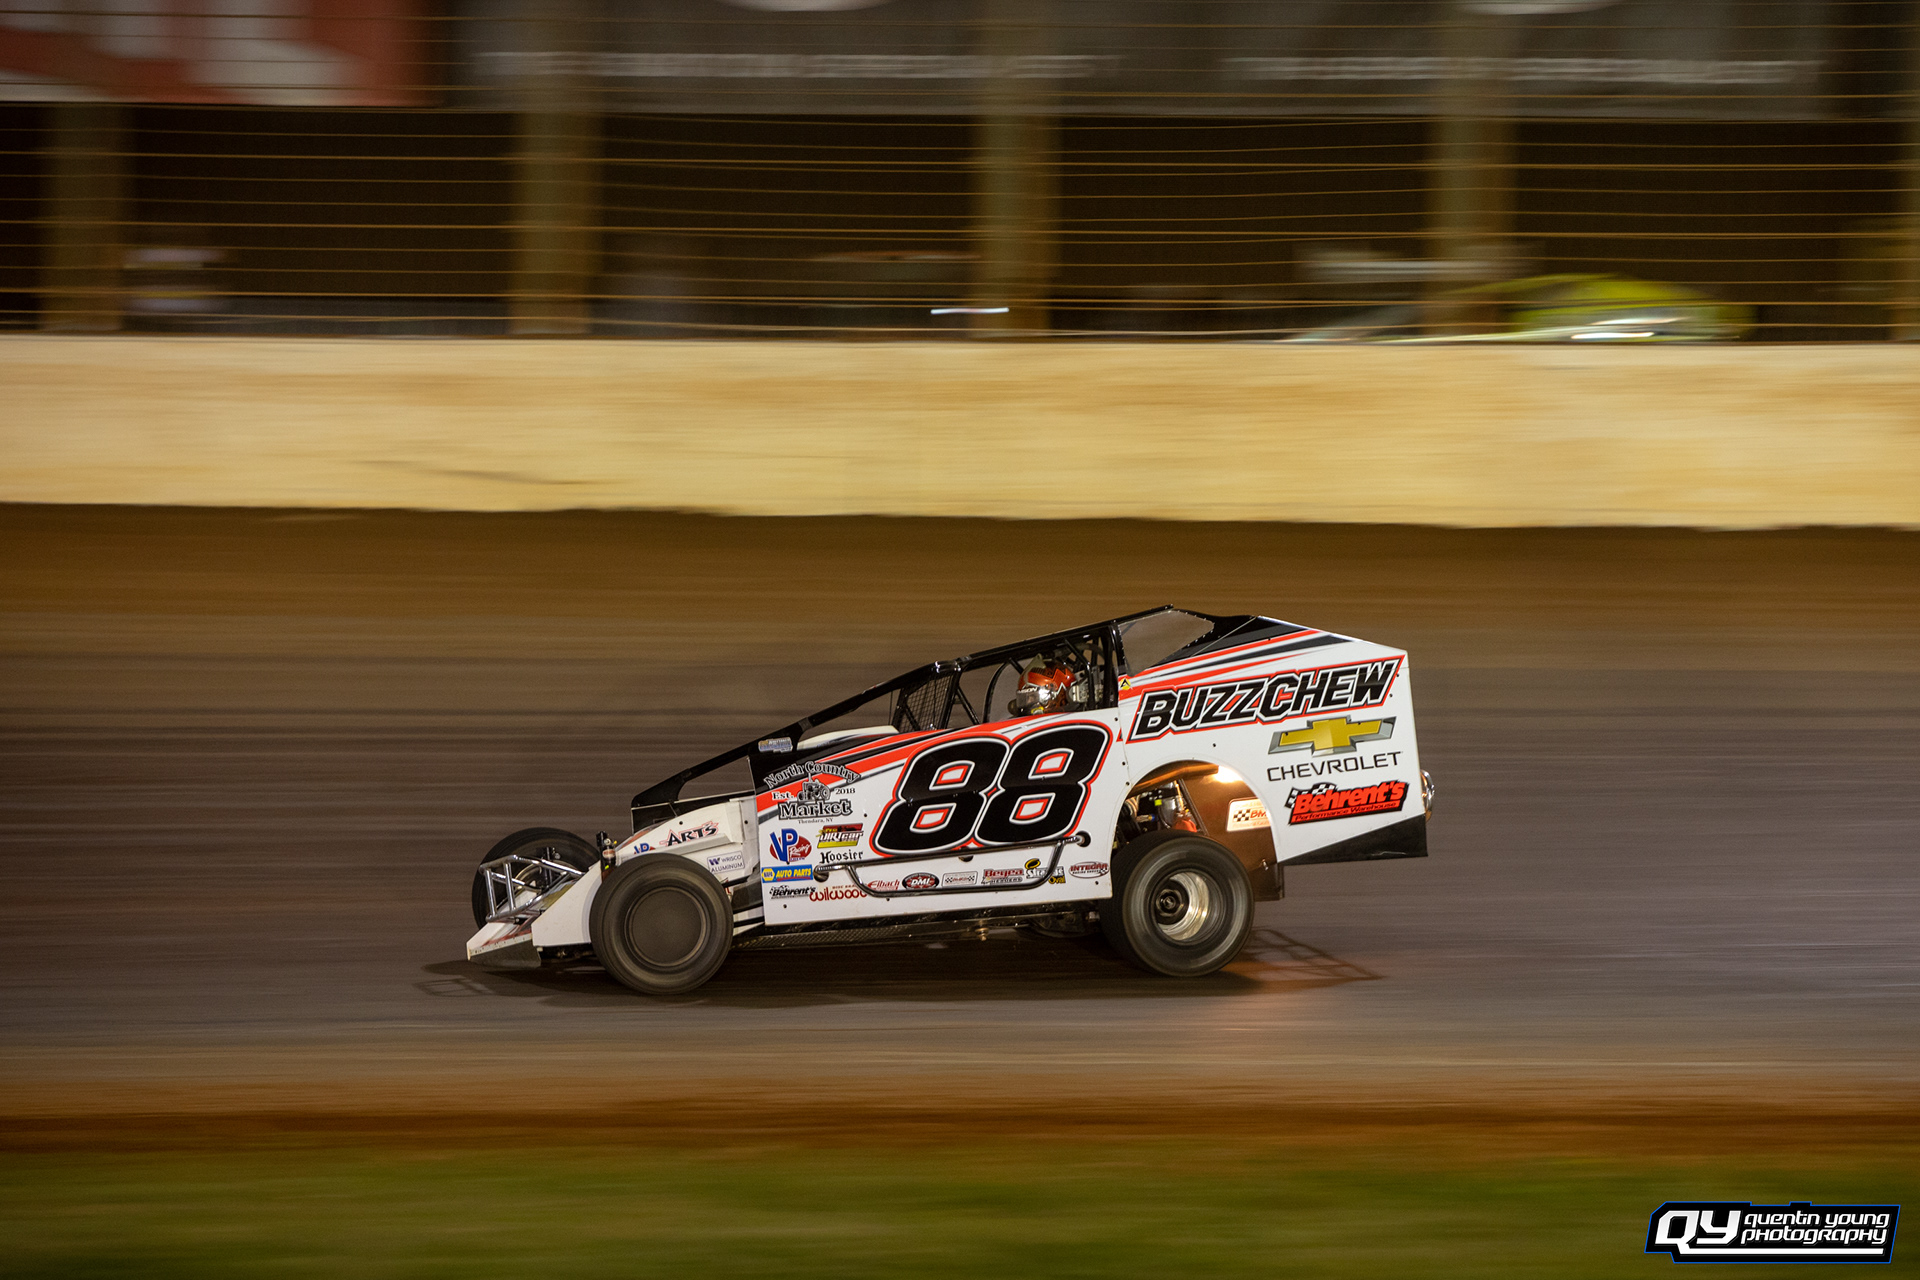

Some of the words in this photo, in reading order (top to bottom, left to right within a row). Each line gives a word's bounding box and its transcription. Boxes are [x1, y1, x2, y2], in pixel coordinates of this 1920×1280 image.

[1130, 659, 1401, 741] BUZZCHEW
[763, 763, 805, 789] North
[804, 760, 861, 784] Country
[1267, 751, 1402, 782] CHEVROLET
[772, 791, 794, 800] Est.
[870, 721, 1112, 857] 88
[1293, 780, 1406, 815] Behrent's
[779, 799, 853, 819] Market
[666, 822, 718, 847] ARTS
[769, 828, 798, 862] VP
[711, 863, 744, 873] ALUMINUM
[819, 849, 863, 863] Hoosier
[775, 869, 792, 878] AUTO
[793, 867, 812, 877] PARTS
[911, 877, 931, 886] DMI
